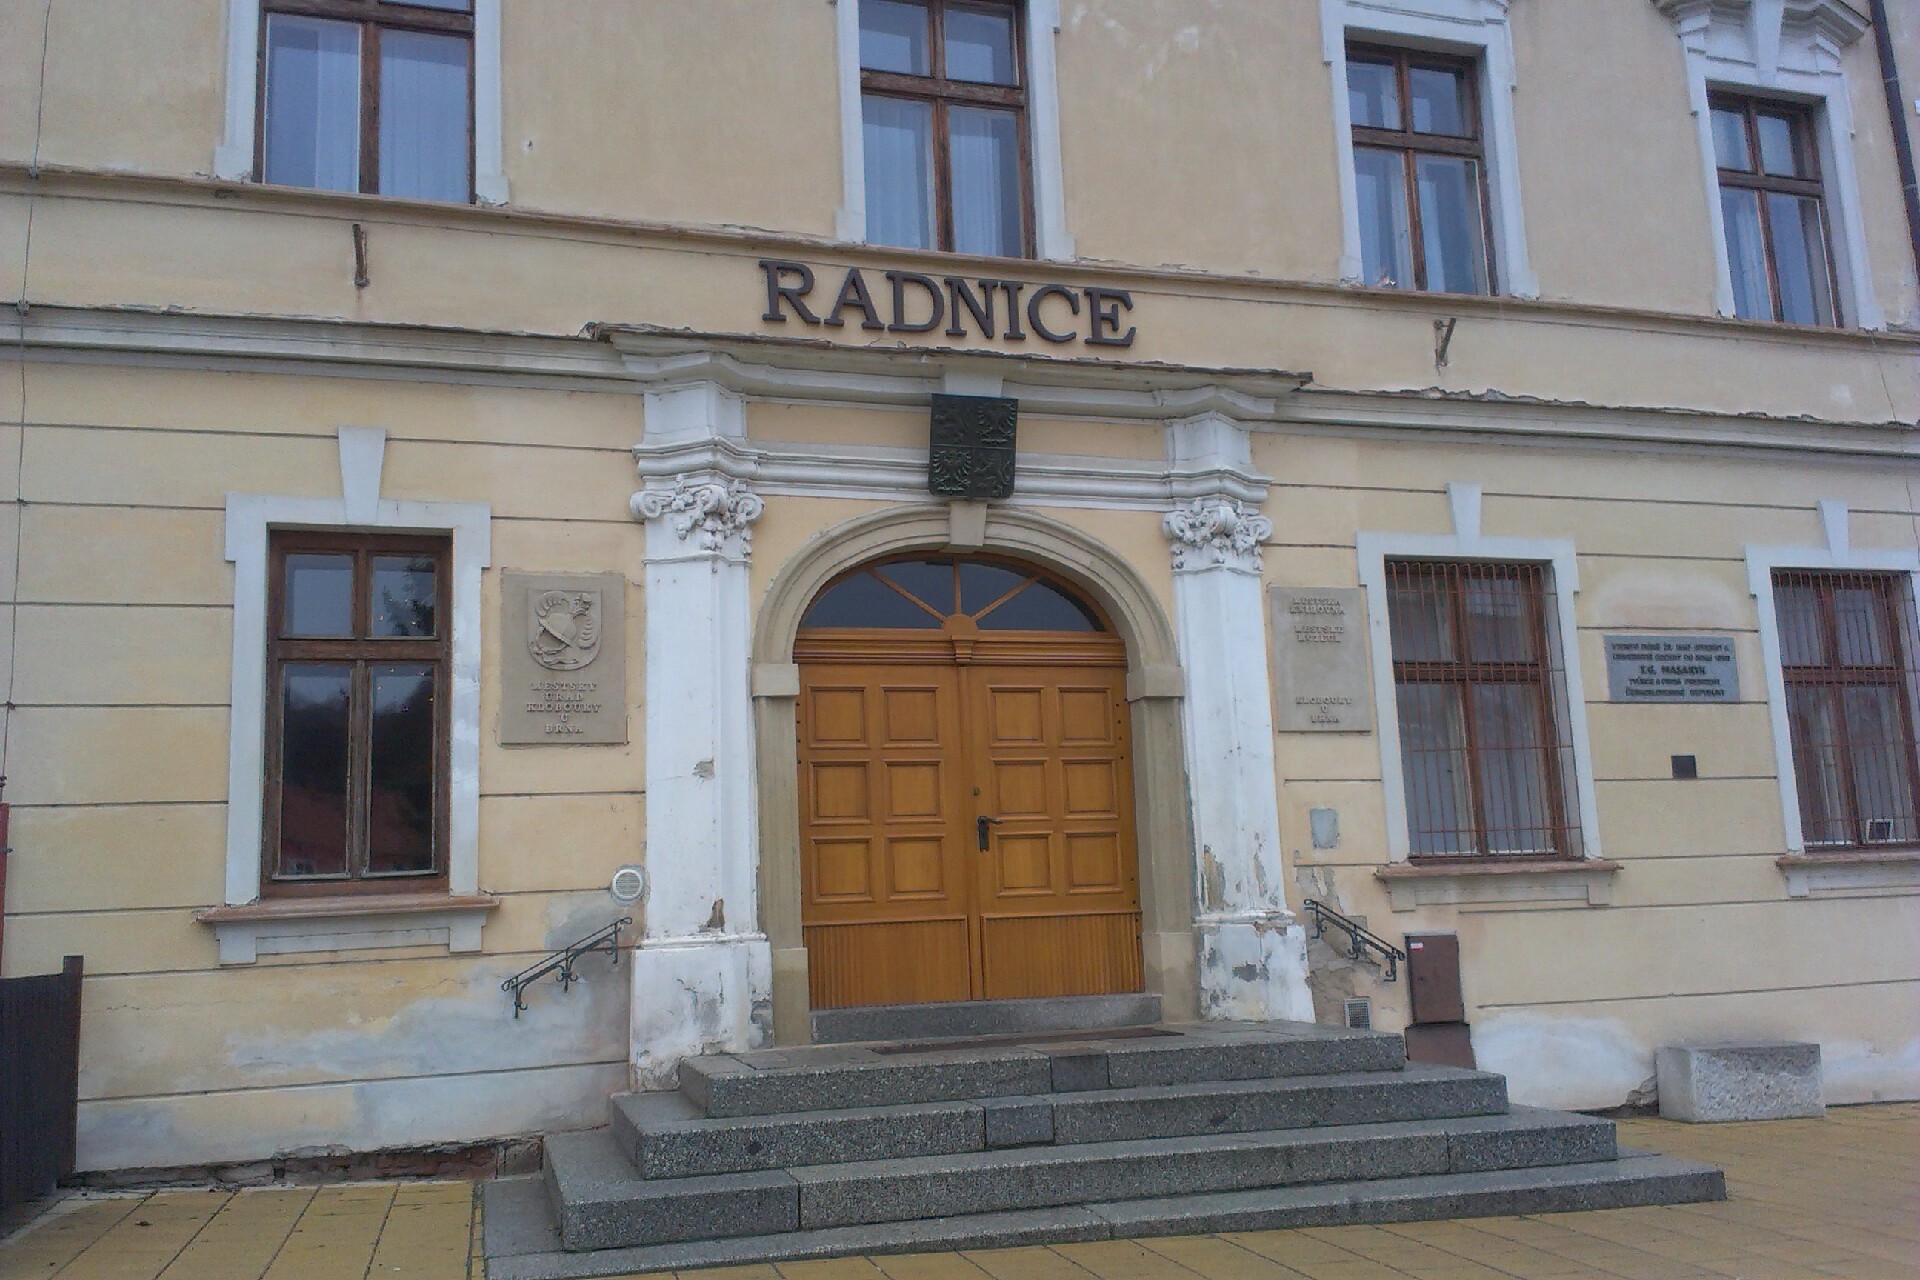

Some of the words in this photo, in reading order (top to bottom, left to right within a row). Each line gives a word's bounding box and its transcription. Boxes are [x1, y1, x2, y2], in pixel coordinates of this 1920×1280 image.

[758, 259, 1137, 348] RADNICE
[526, 702, 602, 713] KLOBOUKY
[559, 713, 568, 722] U
[544, 723, 584, 734] BRNA
